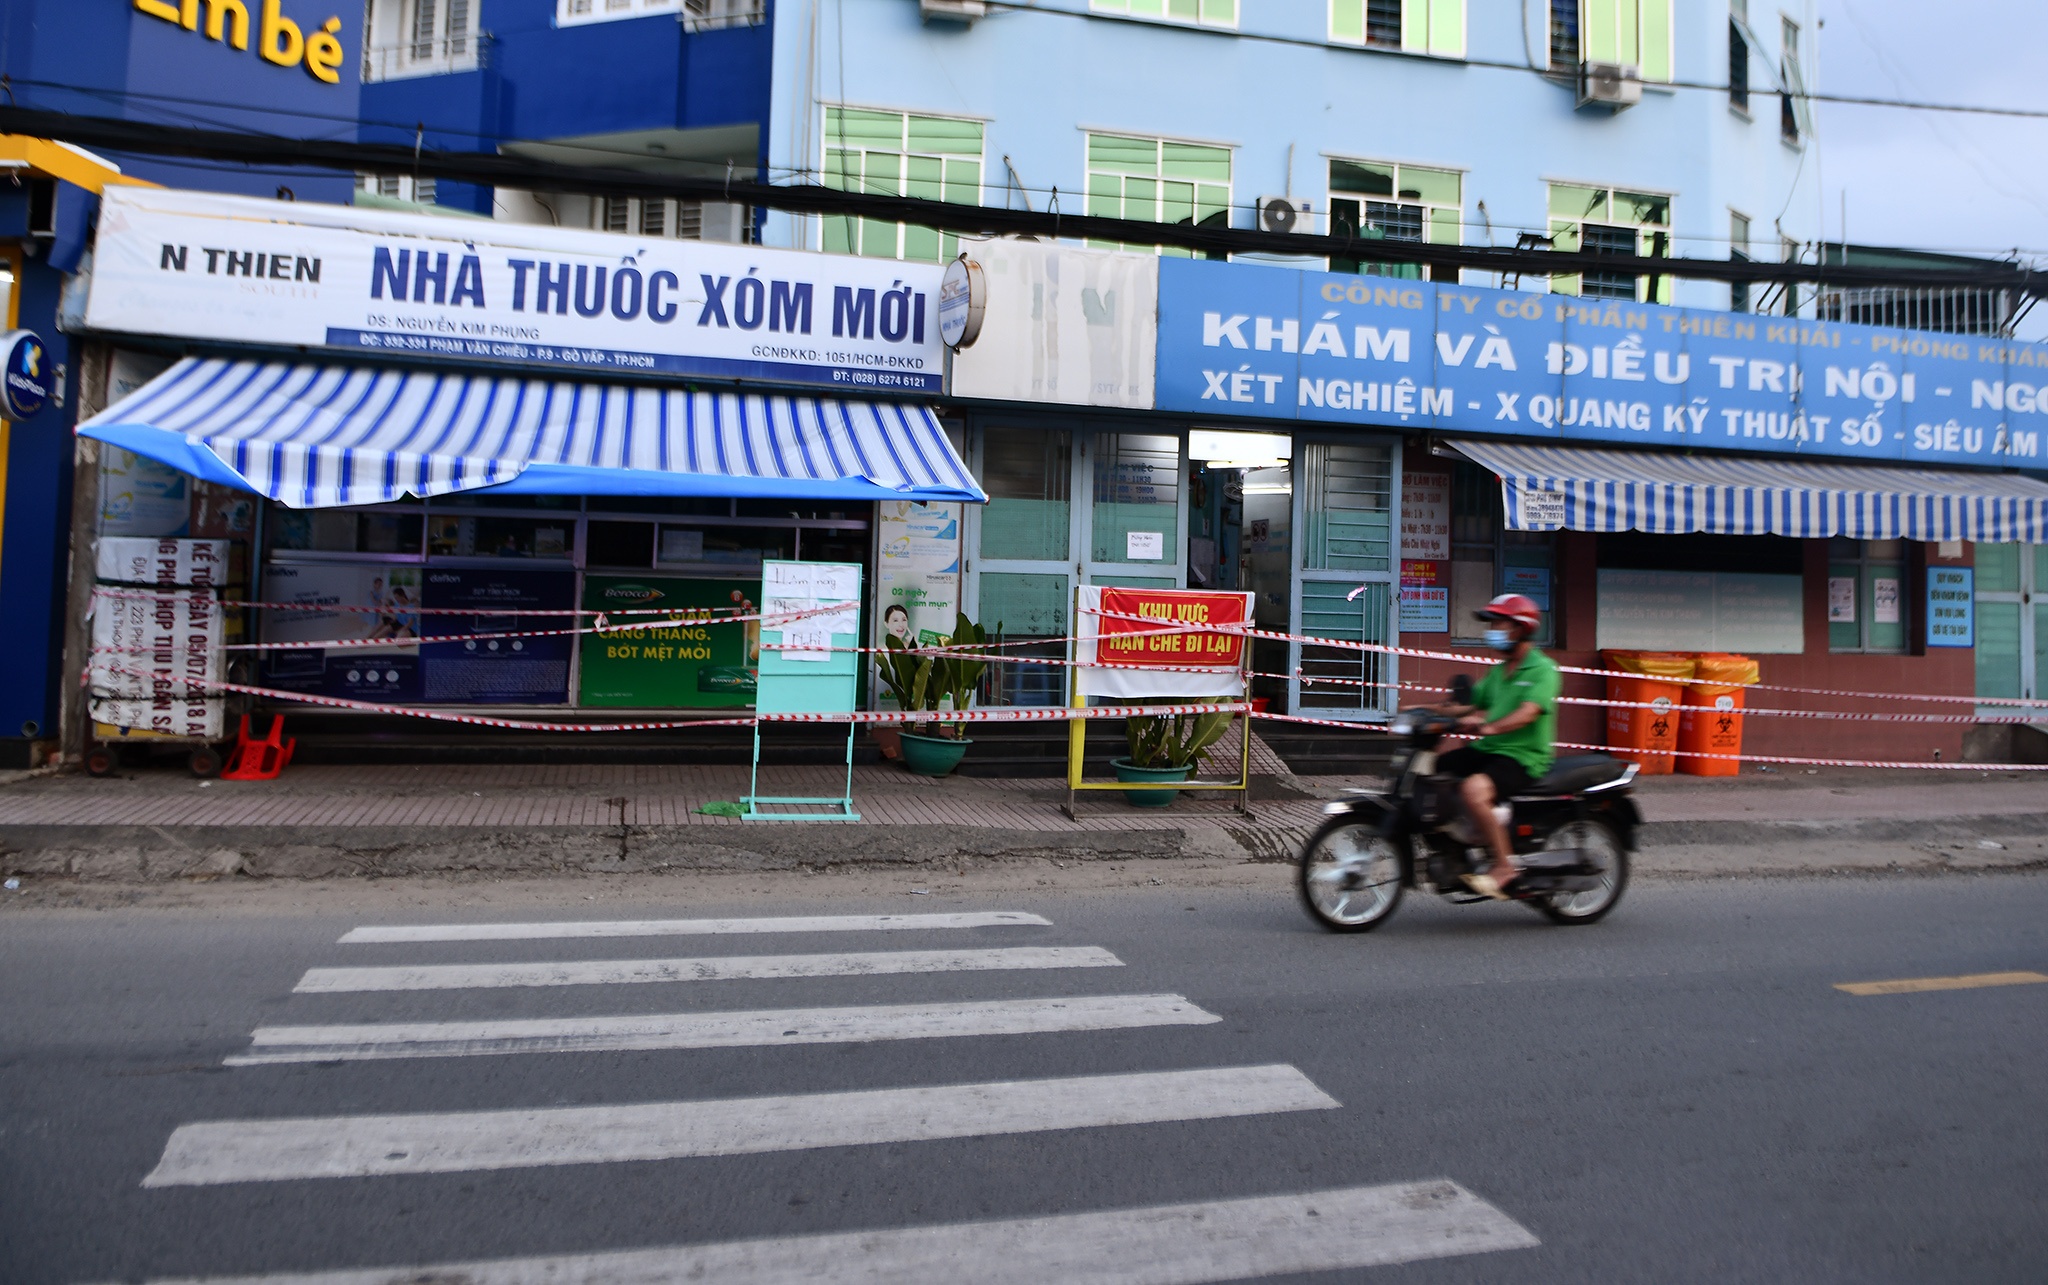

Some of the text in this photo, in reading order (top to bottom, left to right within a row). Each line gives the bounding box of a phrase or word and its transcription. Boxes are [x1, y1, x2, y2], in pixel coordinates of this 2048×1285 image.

[259, 0, 344, 84] bé
[202, 248, 321, 283] THIEN
[371, 242, 926, 345] NHÀ THUỐC XÓM MỚI
[1321, 279, 1423, 310] CÔNG
[1438, 293, 1481, 314] TY
[461, 321, 486, 335] KIM
[429, 337, 464, 354] PHẠM
[562, 348, 580, 362] GÒ
[752, 345, 924, 369] GCNĐKKD: 1051/HCM-ĐKKD
[1203, 311, 1410, 363] KHÁM
[1436, 324, 1517, 371] VÀ
[1545, 332, 1690, 385] ĐIỀU
[1709, 355, 1804, 403] TRỊ
[1825, 361, 1916, 409] NỘI
[1935, 386, 1952, 397] -
[833, 371, 925, 387] ĐT: (028) 6274 6121
[1201, 363, 1283, 404] XÉT
[1298, 376, 1454, 421] NGHIỆM
[1468, 402, 1481, 410] -
[1495, 391, 1520, 421] X
[1528, 394, 1651, 432] QUANG
[1663, 396, 1710, 434] KỸ
[1721, 407, 1832, 449] THUẬT
[1841, 408, 1884, 447] SỐ
[1914, 418, 1983, 454] SIÊU
[1991, 421, 2038, 458] ÂM
[604, 588, 650, 599] Berocca
[892, 588, 928, 598] 02 ngày
[151, 600, 175, 630] HỢP
[1138, 602, 1172, 619] KHU
[607, 642, 711, 662] BỚT MỆT MỎI
[1109, 632, 1145, 654] HẠN
[1186, 636, 1203, 653] ĐI
[1206, 636, 1232, 657] LẠI
